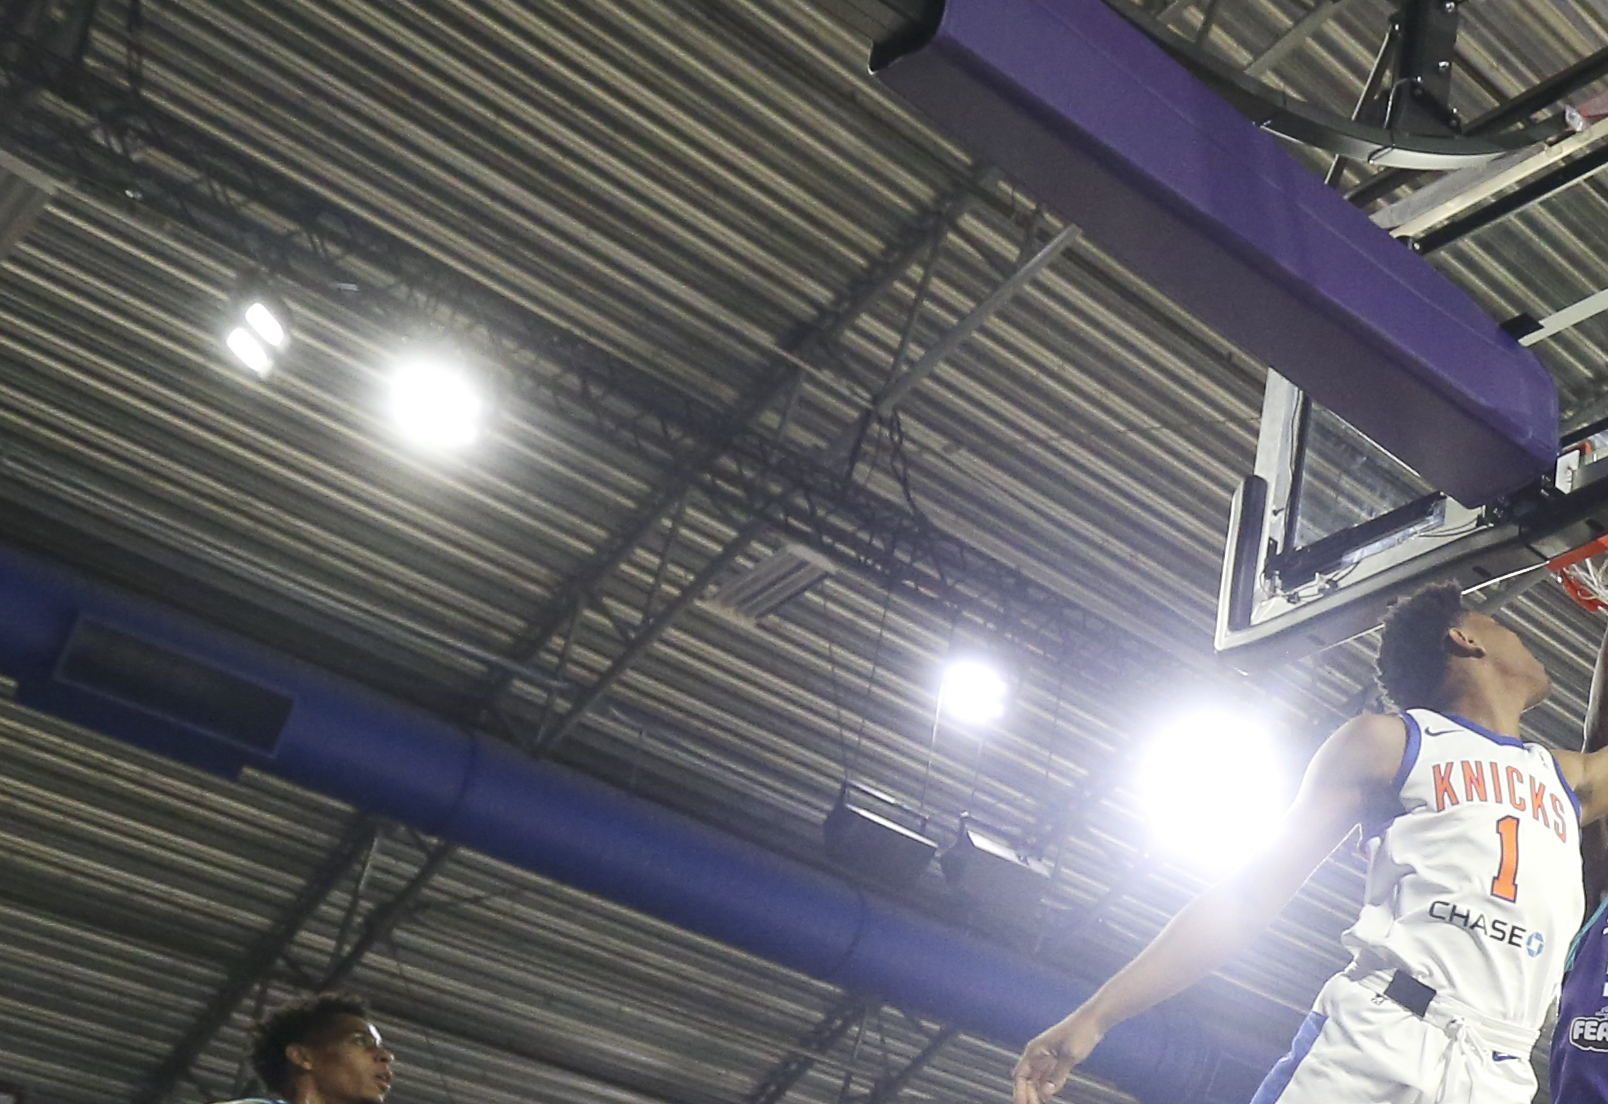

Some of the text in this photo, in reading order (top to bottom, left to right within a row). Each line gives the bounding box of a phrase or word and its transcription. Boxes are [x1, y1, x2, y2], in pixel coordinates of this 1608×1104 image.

[1432, 760, 1567, 843] KNICKS
[1490, 815, 1519, 903] 1
[1429, 901, 1527, 948] CHASE
